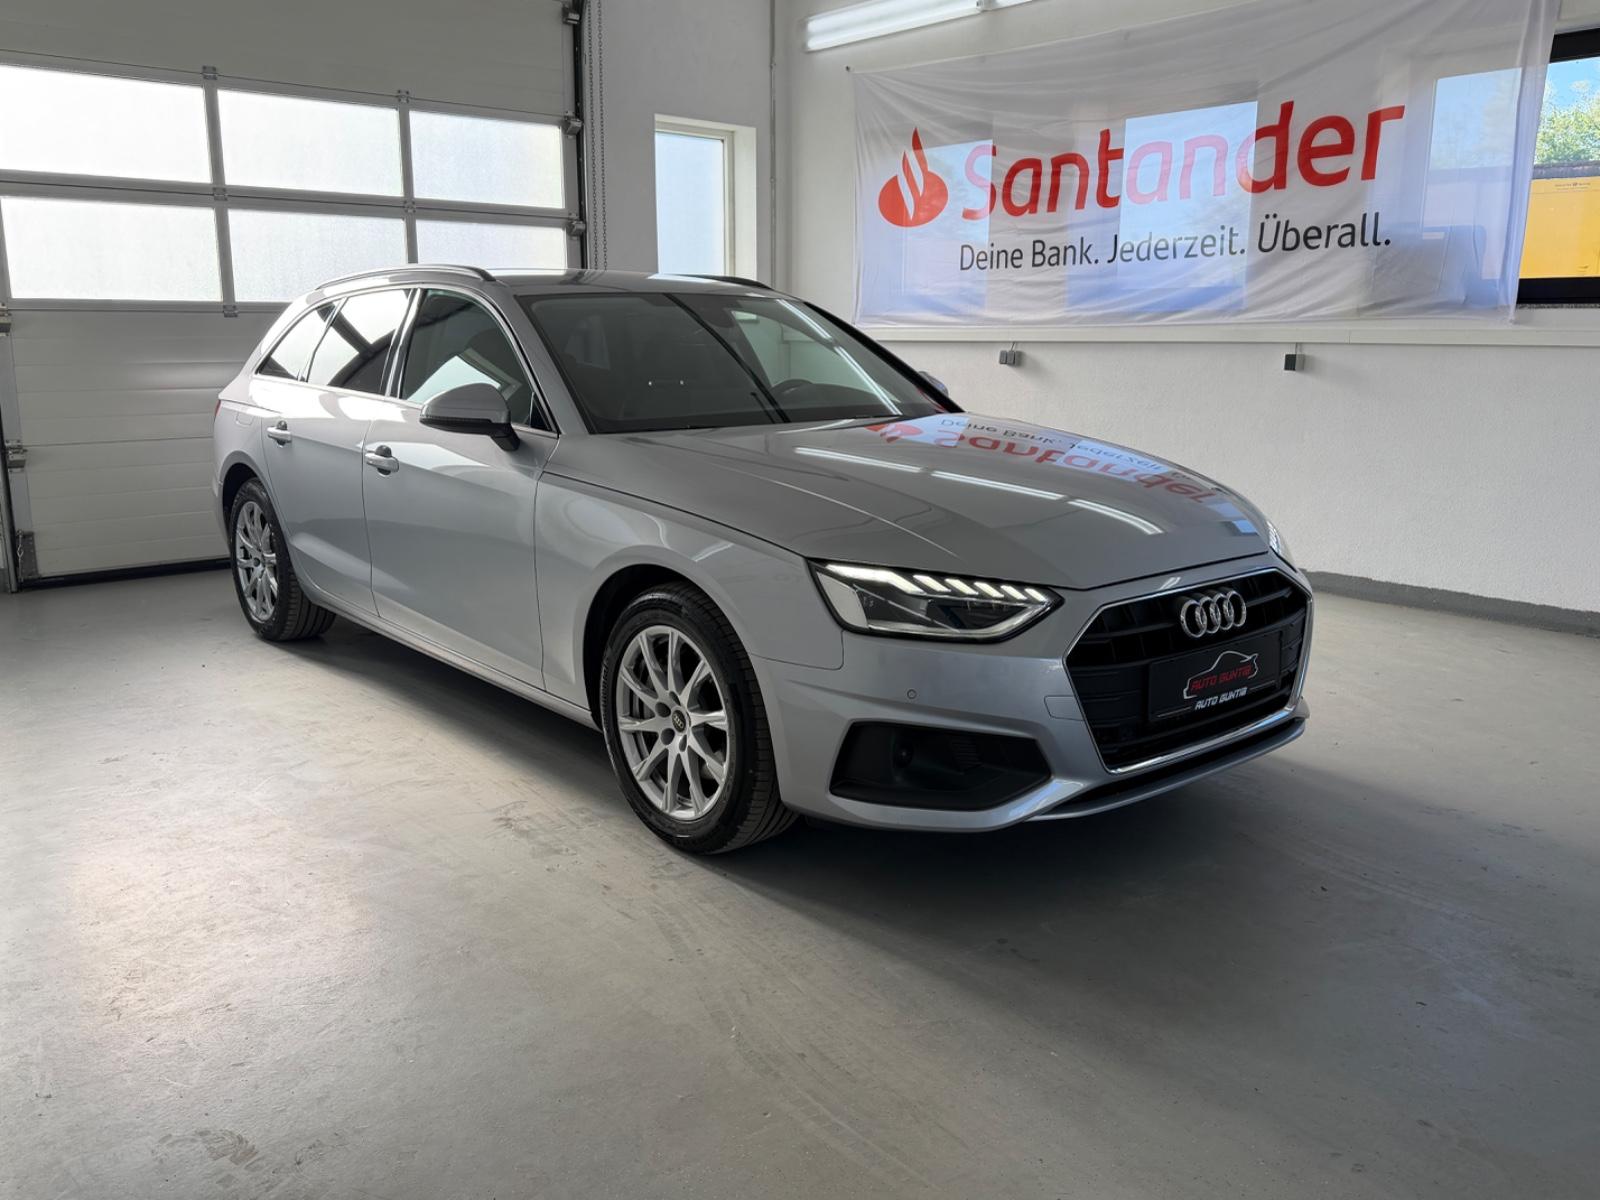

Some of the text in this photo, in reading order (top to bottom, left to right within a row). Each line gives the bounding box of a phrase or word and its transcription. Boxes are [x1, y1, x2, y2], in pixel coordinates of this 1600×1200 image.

[962, 100, 1406, 220] Santander
[959, 213, 1392, 271] Deine Bank. Jederzeit. Überall.
[1191, 676, 1217, 691] AUTO
[1195, 696, 1218, 710] AUTO
